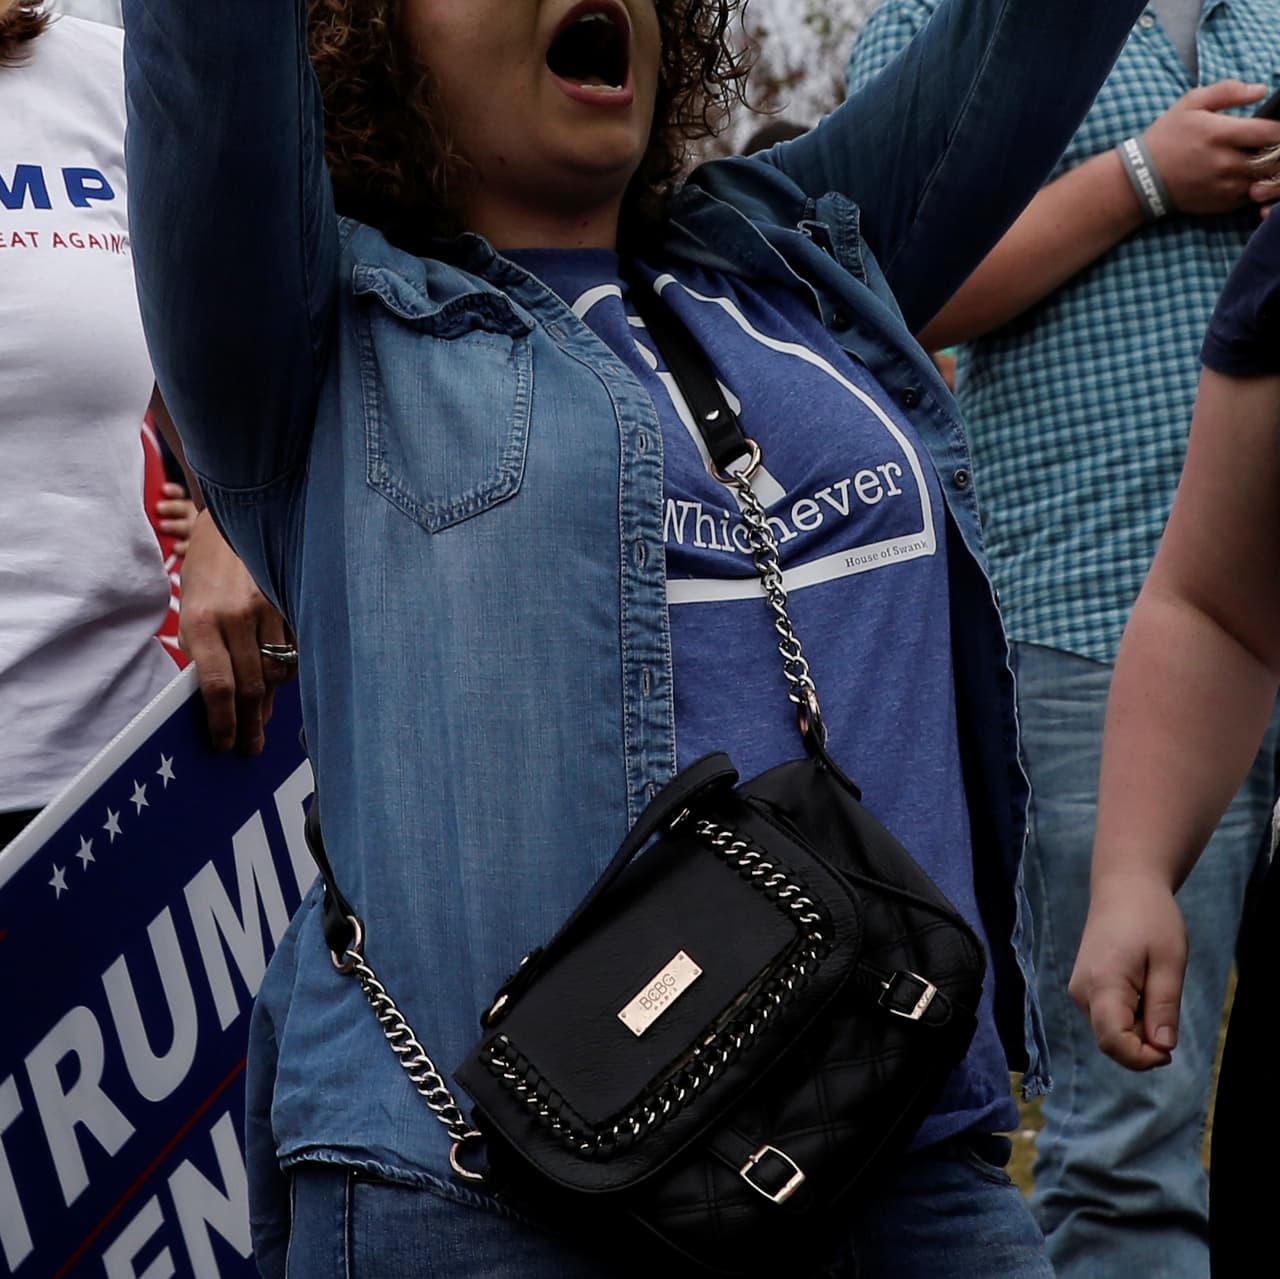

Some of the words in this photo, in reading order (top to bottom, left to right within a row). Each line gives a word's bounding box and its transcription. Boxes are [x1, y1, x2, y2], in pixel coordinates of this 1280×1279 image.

[844, 552, 879, 568] House
[880, 547, 892, 559] of
[892, 539, 928, 557] Swank
[638, 972, 676, 1011] BCBG
